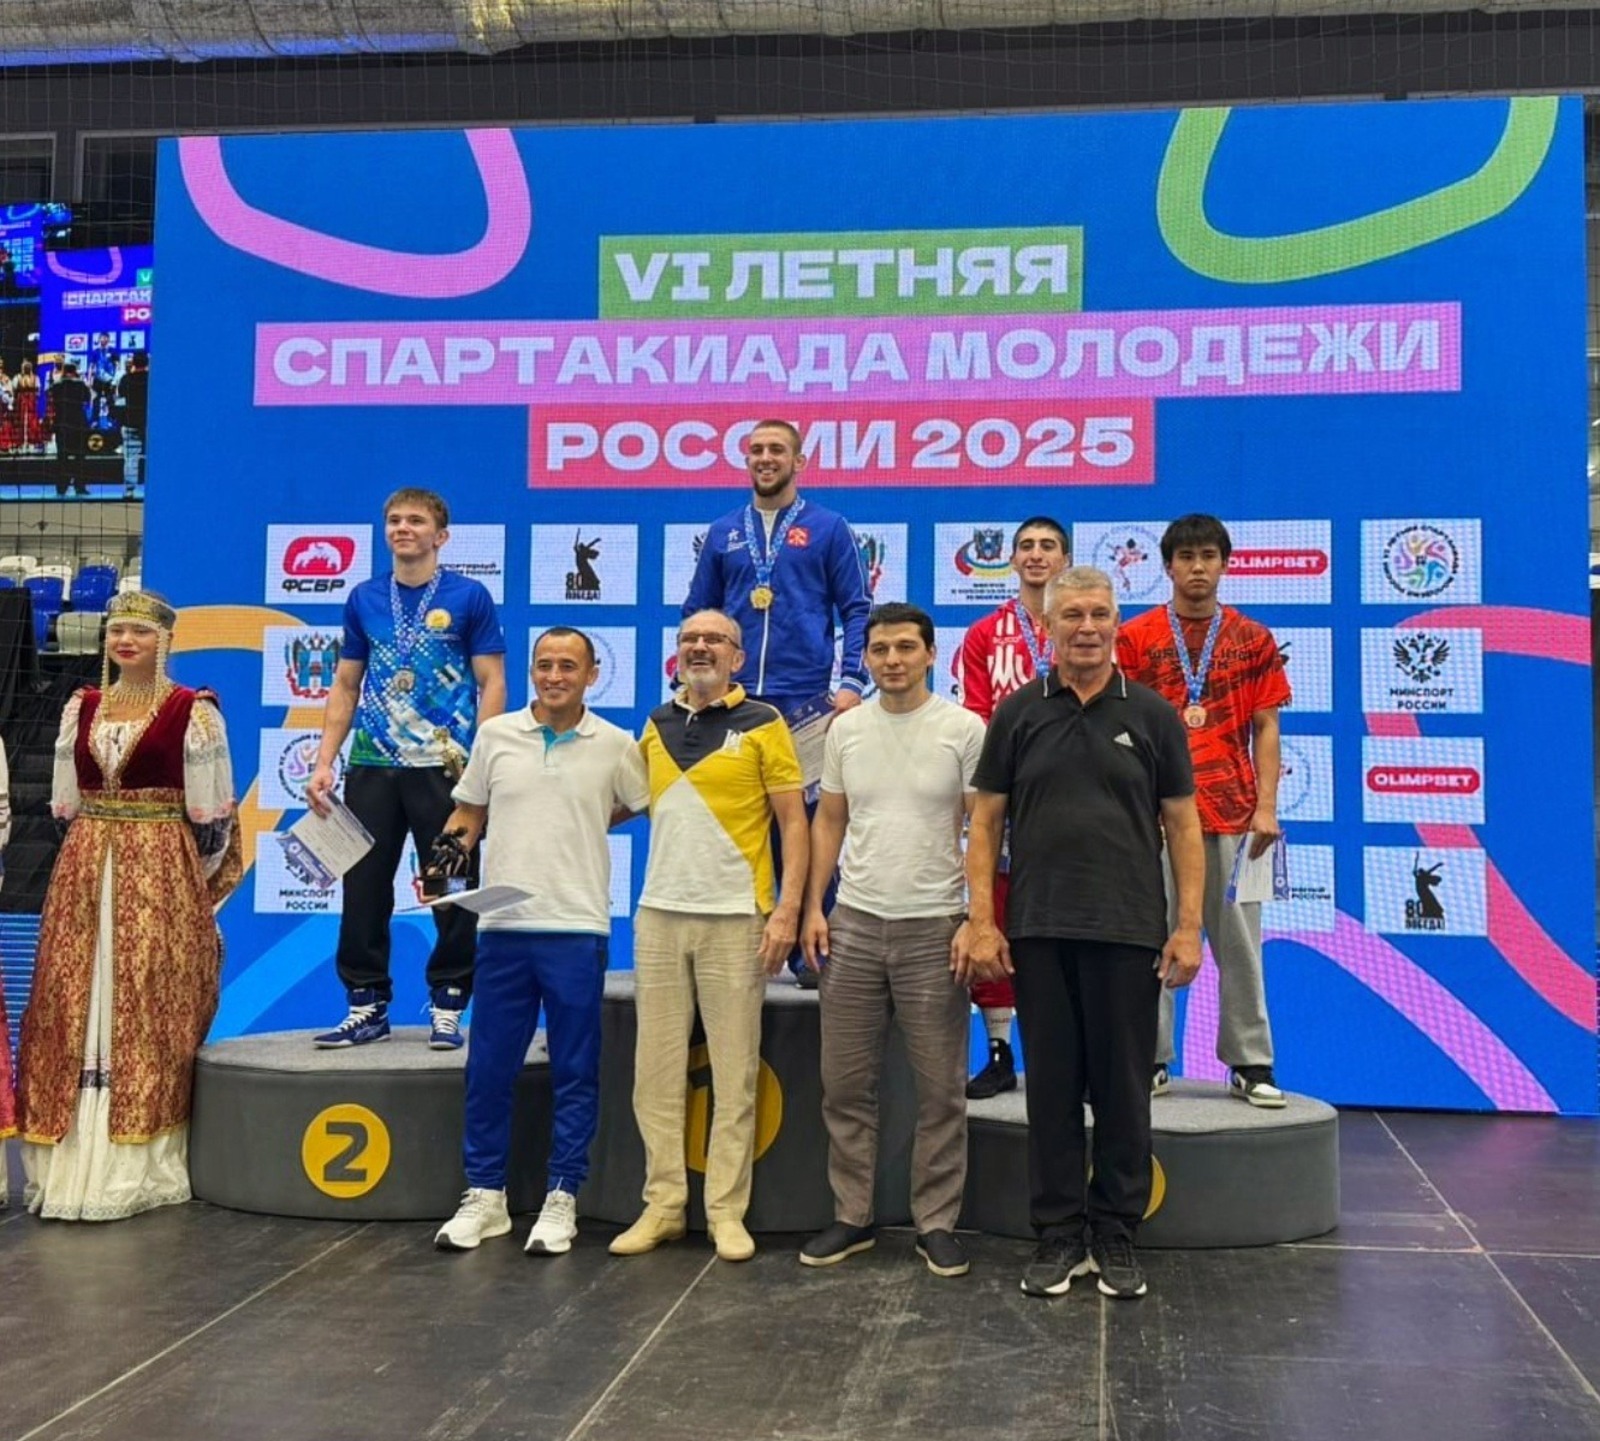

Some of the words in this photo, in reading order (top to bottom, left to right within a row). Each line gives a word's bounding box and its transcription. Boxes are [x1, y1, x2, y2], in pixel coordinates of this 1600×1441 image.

[614, 252, 710, 301] VI
[725, 244, 1069, 299] ЛЕТНЯЯ
[272, 332, 909, 392] СПАРТАКИАДА
[925, 319, 1440, 386] МОЛОДЕЖИ
[911, 416, 1135, 468] 2025
[281, 579, 346, 592] ФСБР
[1389, 687, 1454, 697] МИНСПОРТ
[1397, 700, 1446, 710] РОССИИ
[1374, 774, 1472, 787] OLIMPBET
[279, 889, 336, 899] МИНСПОРТ
[285, 901, 329, 910] РОССИИ
[323, 1121, 369, 1182] 2
